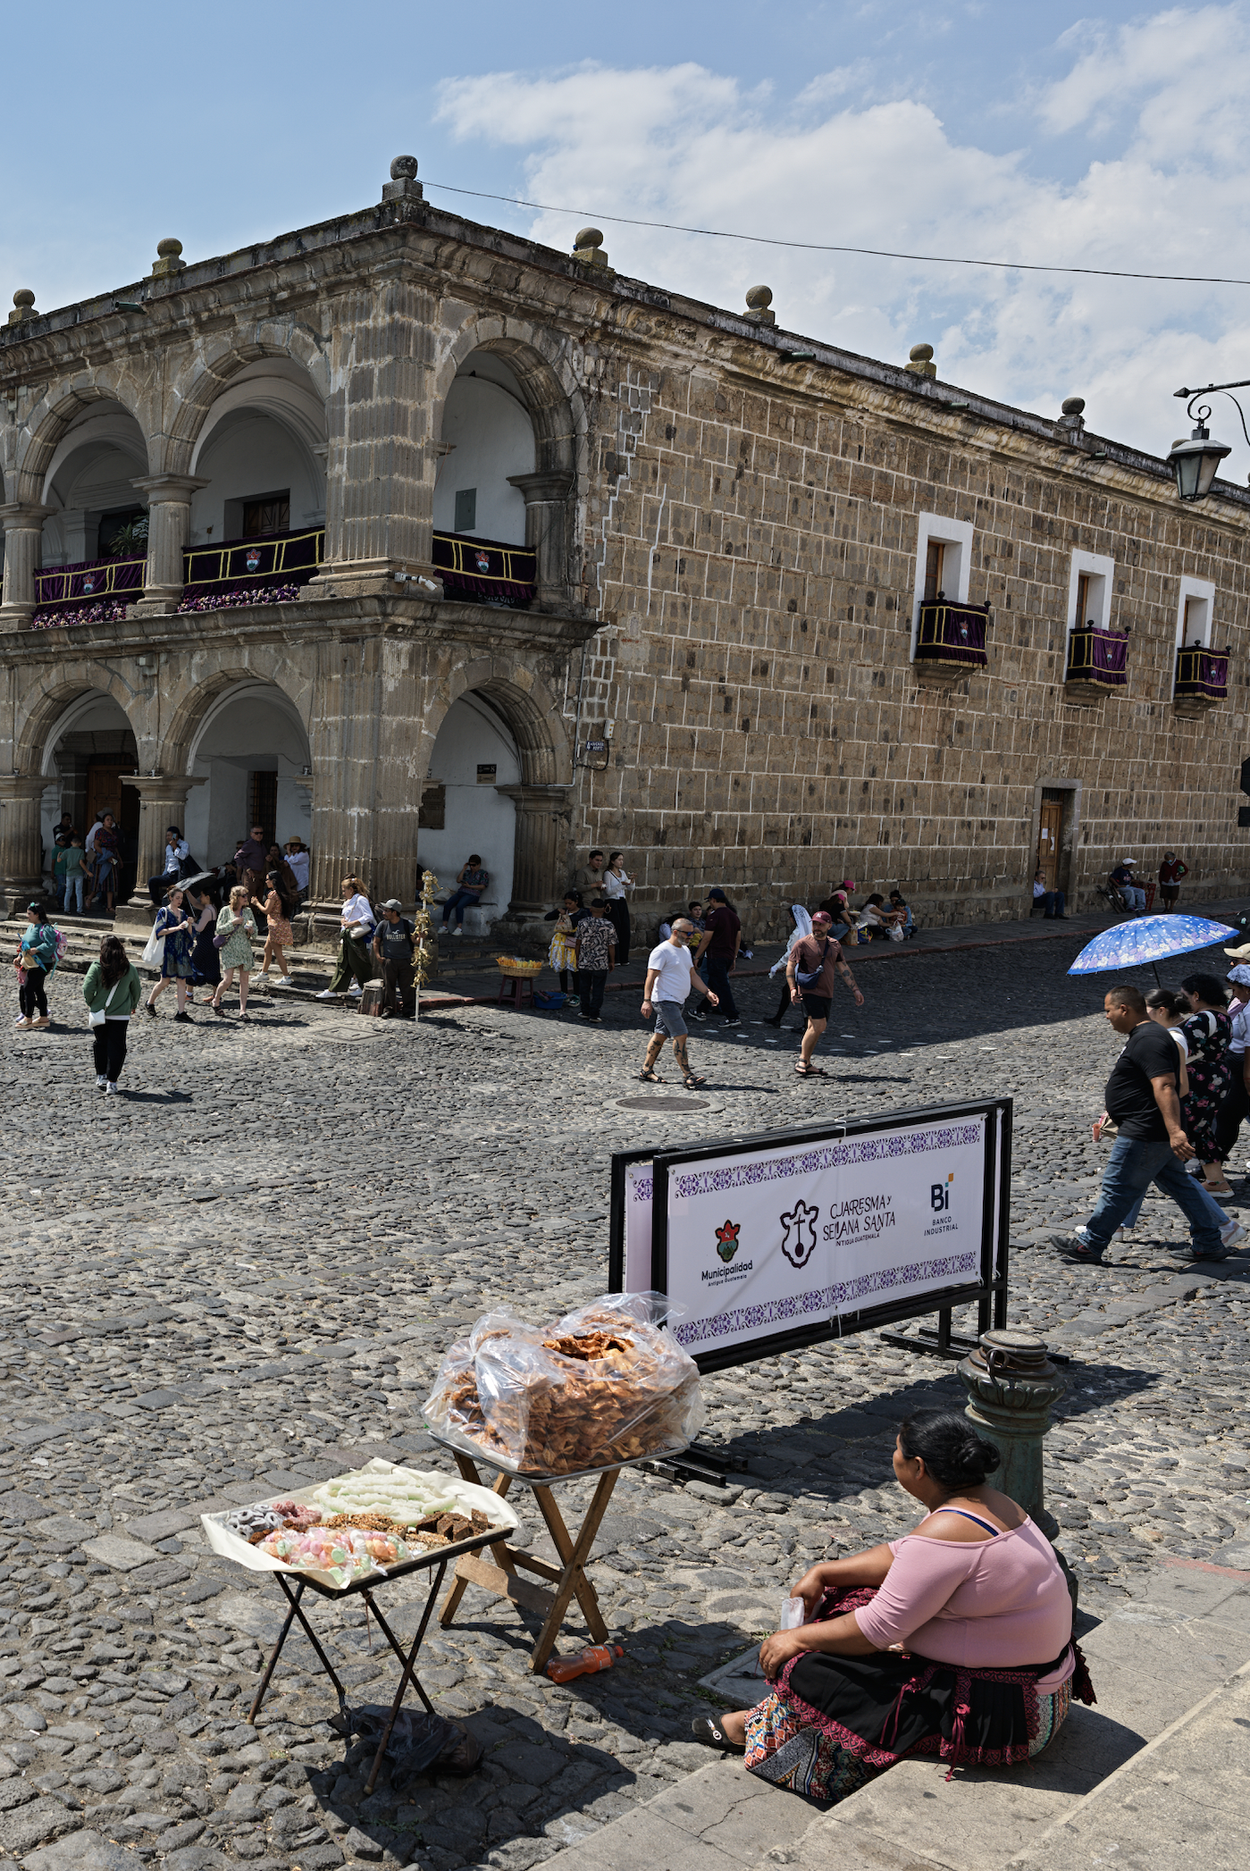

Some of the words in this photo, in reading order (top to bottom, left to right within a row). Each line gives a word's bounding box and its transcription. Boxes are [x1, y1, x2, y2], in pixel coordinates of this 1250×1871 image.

[931, 1182, 949, 1212] Bi
[863, 1211, 896, 1232] SANTA
[932, 1215, 952, 1226] BANCO
[924, 1223, 959, 1236] INDUSTRIAL
[835, 1238, 854, 1247] NTIGUA
[701, 1260, 753, 1281] Municipalidad
